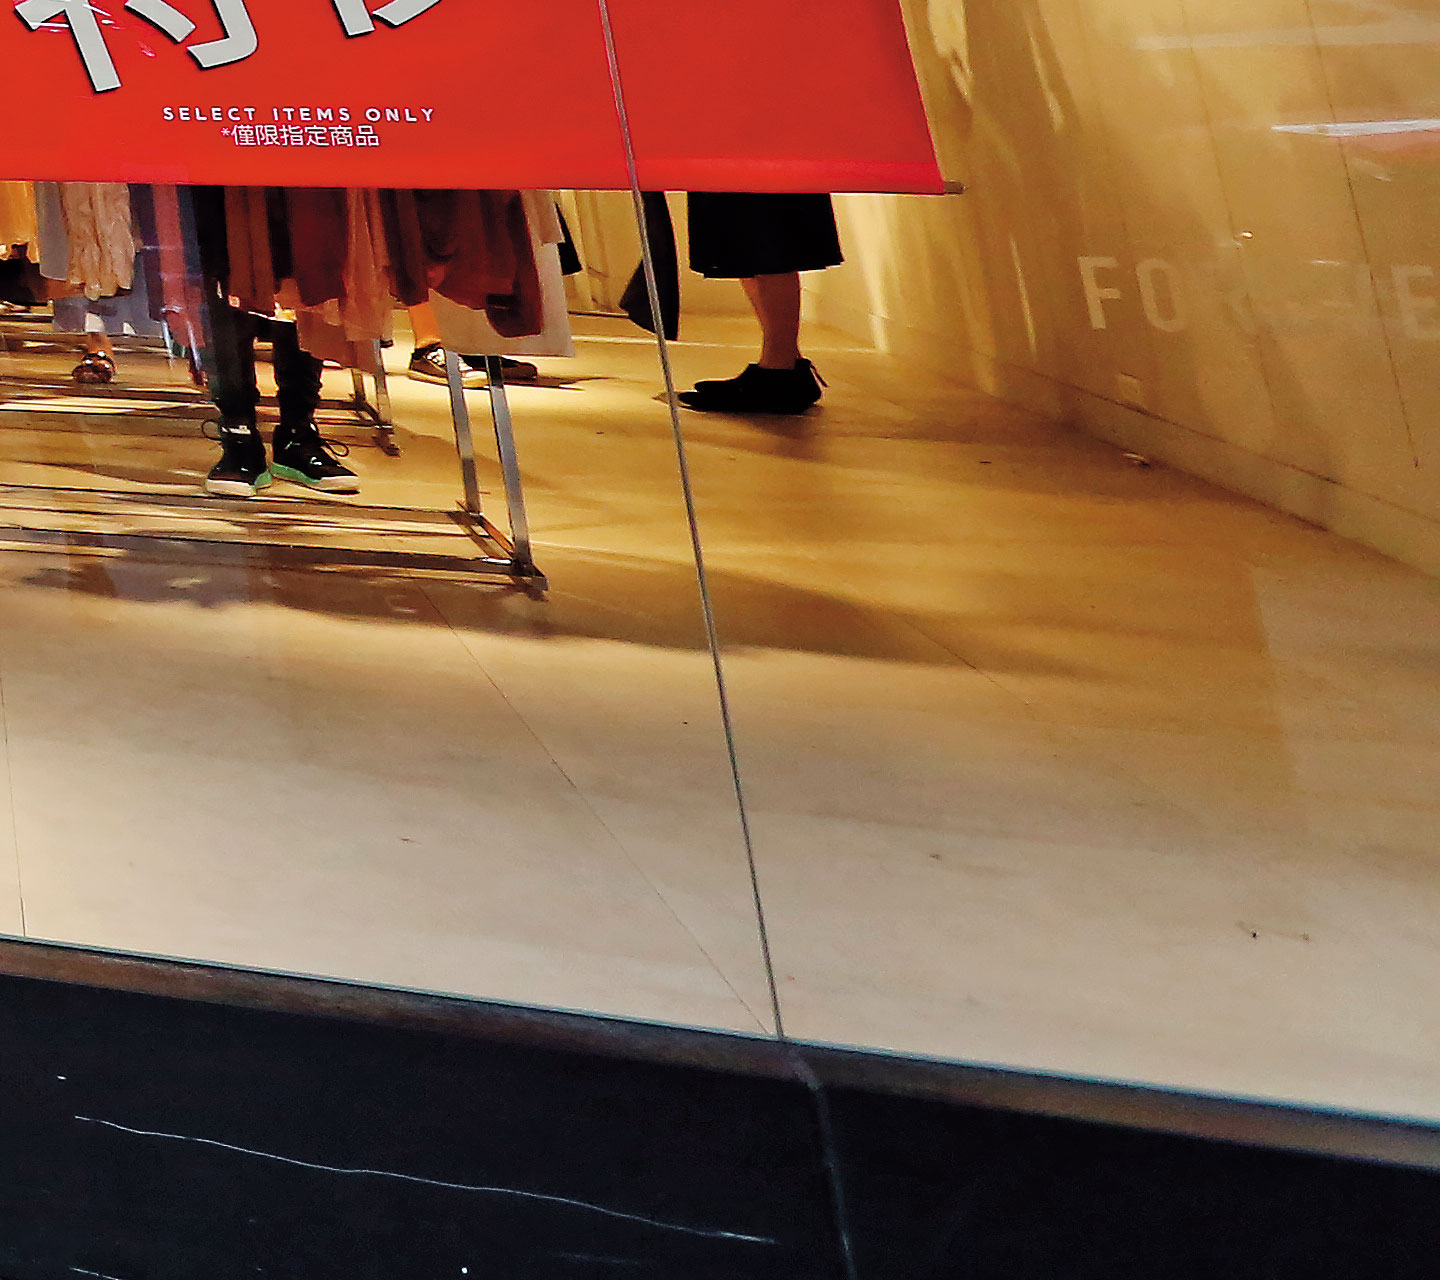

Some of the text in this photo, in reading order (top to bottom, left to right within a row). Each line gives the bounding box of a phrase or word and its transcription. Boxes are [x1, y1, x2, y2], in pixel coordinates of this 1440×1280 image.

[162, 106, 435, 123] SELECT ITEMS ONLY
